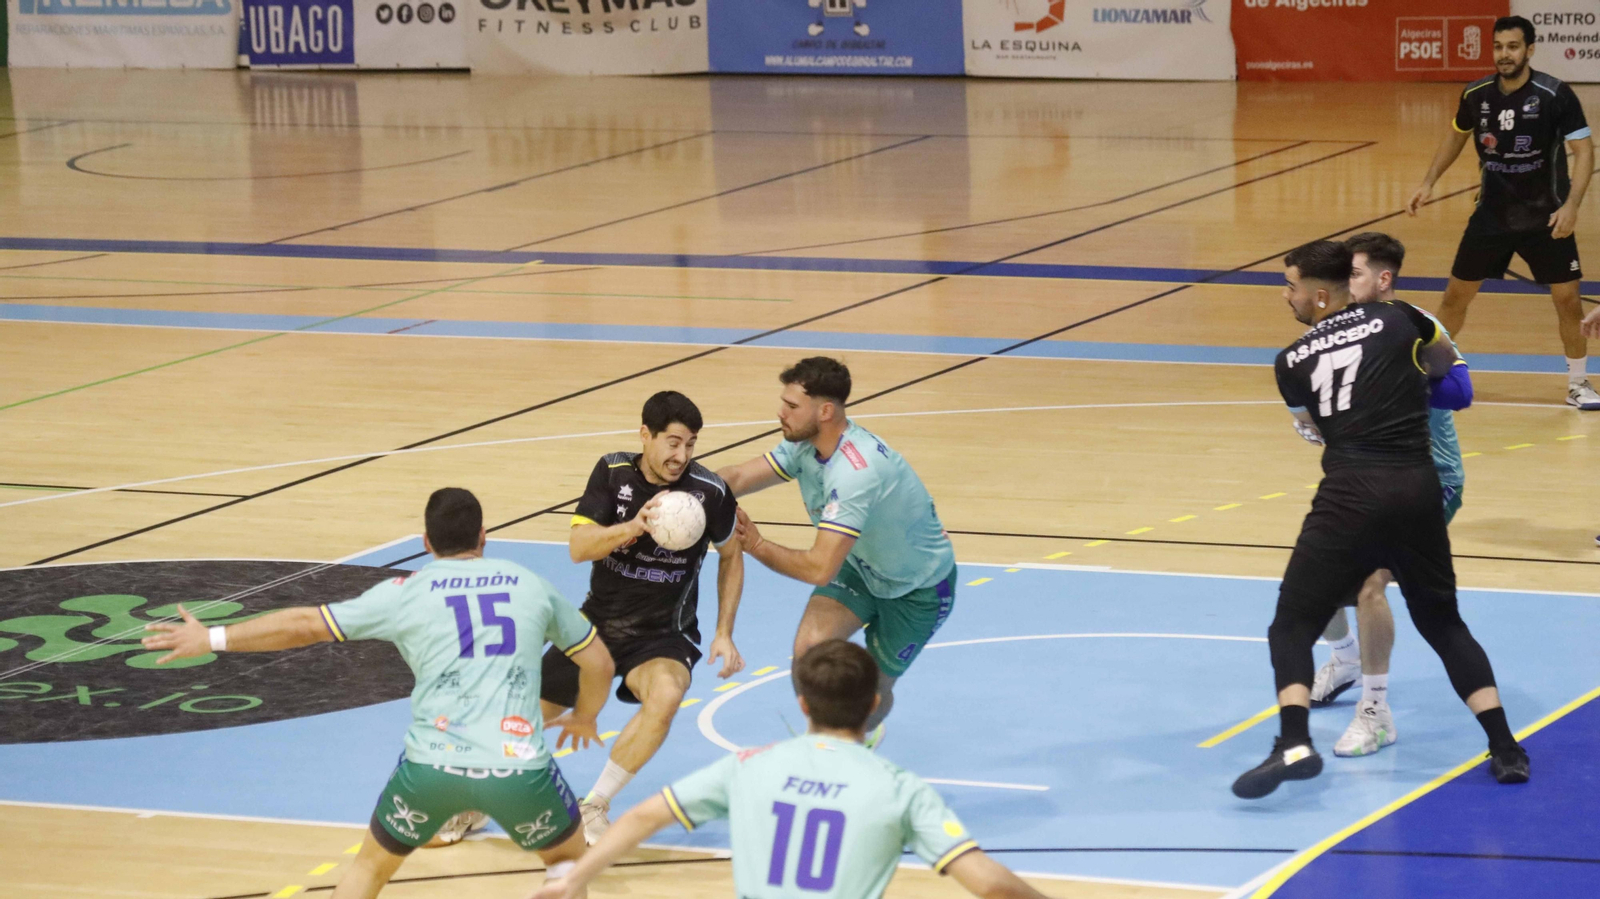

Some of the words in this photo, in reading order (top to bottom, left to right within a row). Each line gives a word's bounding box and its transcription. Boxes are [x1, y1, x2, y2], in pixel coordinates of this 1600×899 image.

[478, 18, 615, 35] FITNESS
[630, 15, 702, 33] CLUB
[1093, 8, 1192, 24] LIONZAMAR
[1532, 12, 1596, 26] CENTRO
[249, 5, 343, 54] UBAGO
[1401, 28, 1442, 39] Algeciras
[1548, 32, 1600, 43] Menénd
[971, 39, 992, 51] LA
[1000, 39, 1082, 52] ESQUINA
[1400, 41, 1442, 59] PSOE
[1578, 48, 1600, 60] 956
[1286, 318, 1384, 368] P.SAUCEDO
[1310, 344, 1363, 417] 17
[430, 571, 519, 592] MOLDÓN
[444, 592, 518, 659] 15
[783, 776, 848, 799] FONT
[385, 813, 420, 840] SILBON
[767, 800, 846, 893] 10
